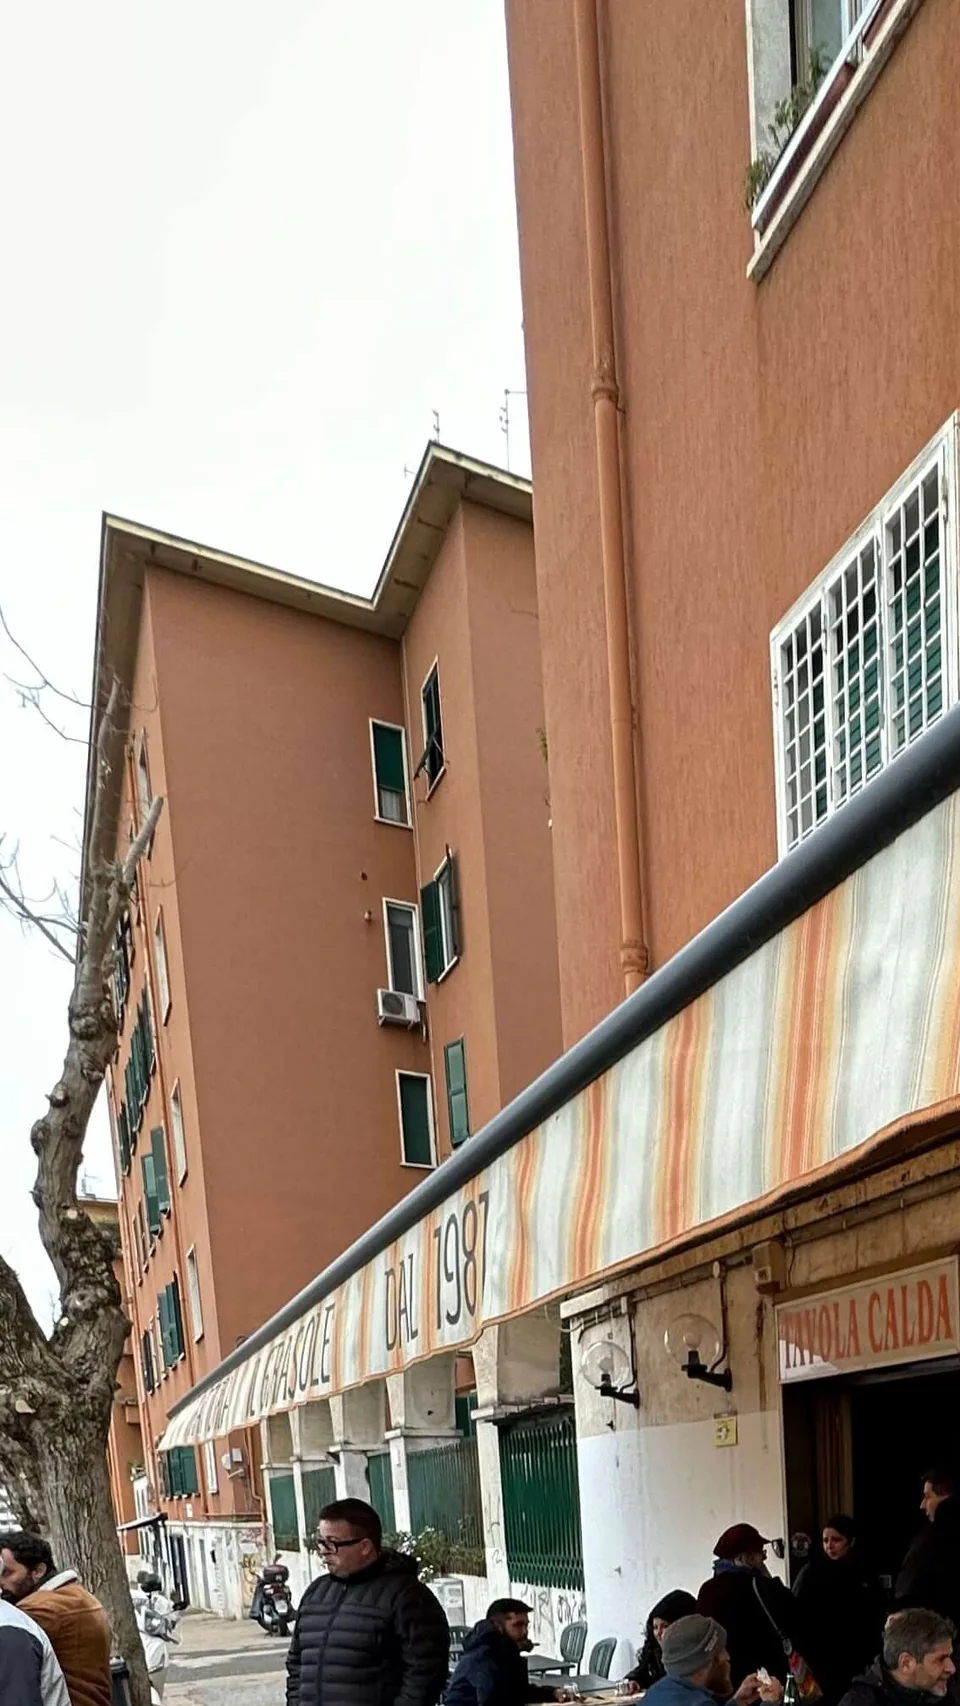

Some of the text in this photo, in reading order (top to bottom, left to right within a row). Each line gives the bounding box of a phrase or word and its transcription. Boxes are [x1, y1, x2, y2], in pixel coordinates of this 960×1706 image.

[260, 1303, 335, 1412] GRASOLE
[385, 1252, 418, 1352] DAL
[433, 1190, 490, 1330] 1987
[867, 1272, 954, 1354] CALDA
